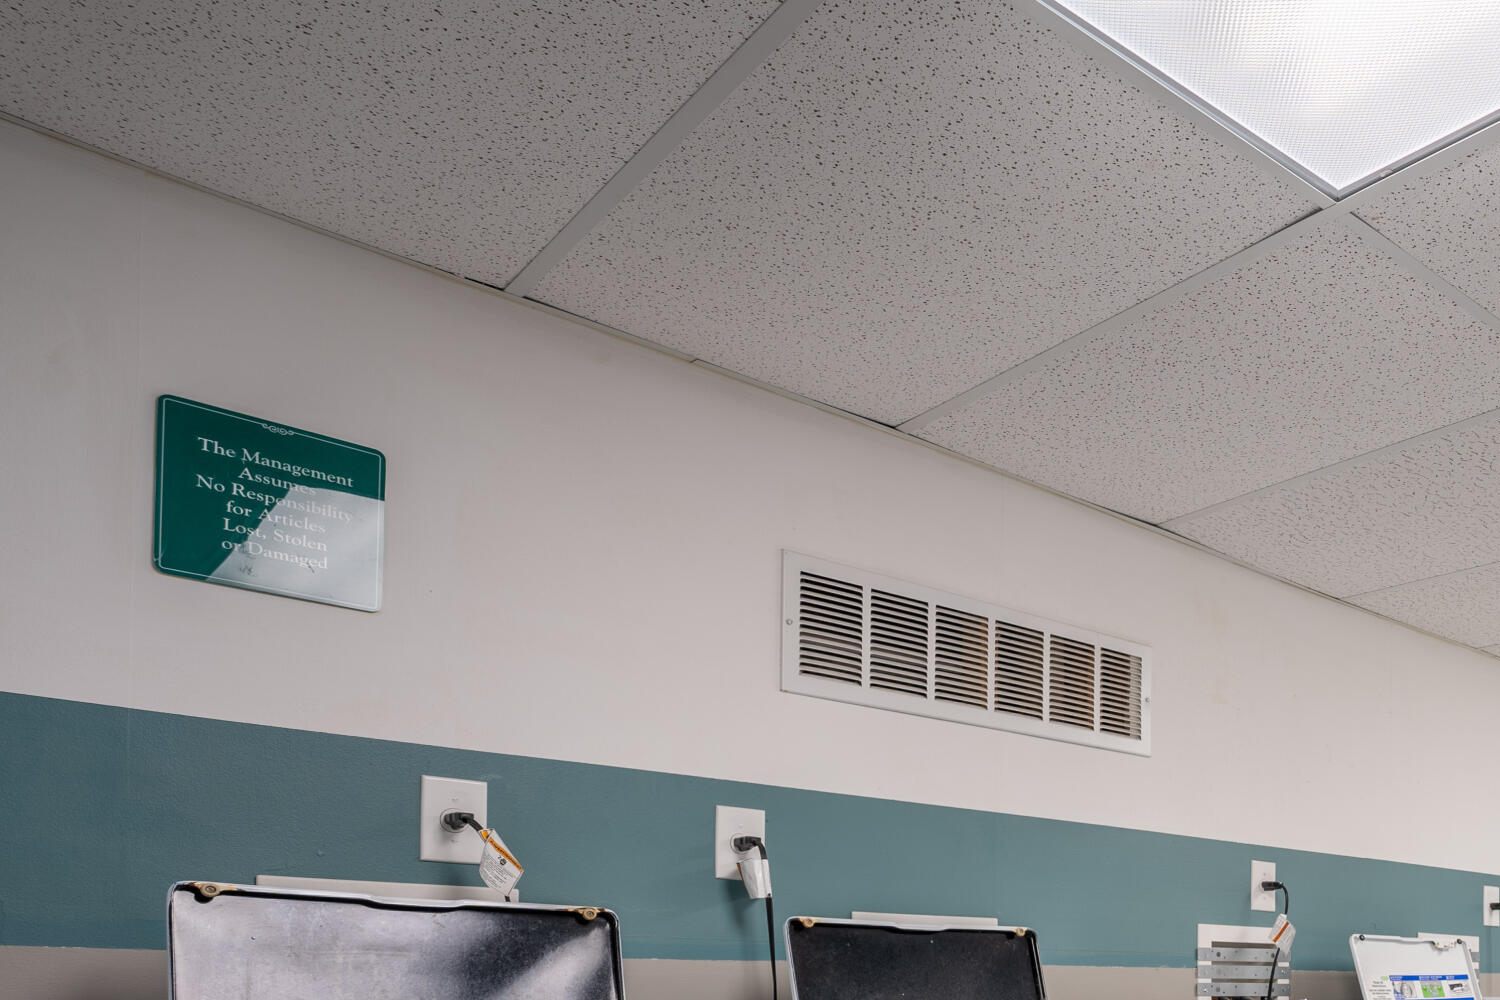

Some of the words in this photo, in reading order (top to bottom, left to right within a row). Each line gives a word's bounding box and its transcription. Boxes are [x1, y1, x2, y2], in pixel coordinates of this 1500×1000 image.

[198, 437, 236, 458] The
[242, 448, 354, 487] Management
[238, 468, 316, 496] Assumes
[196, 474, 225, 492] No
[232, 483, 354, 525] Responsibility
[226, 501, 252, 516] for
[258, 510, 326, 534] Articles
[223, 518, 267, 539] Lost,
[274, 529, 328, 552] Stolen
[222, 541, 242, 552] or
[248, 542, 328, 570] Damaged
